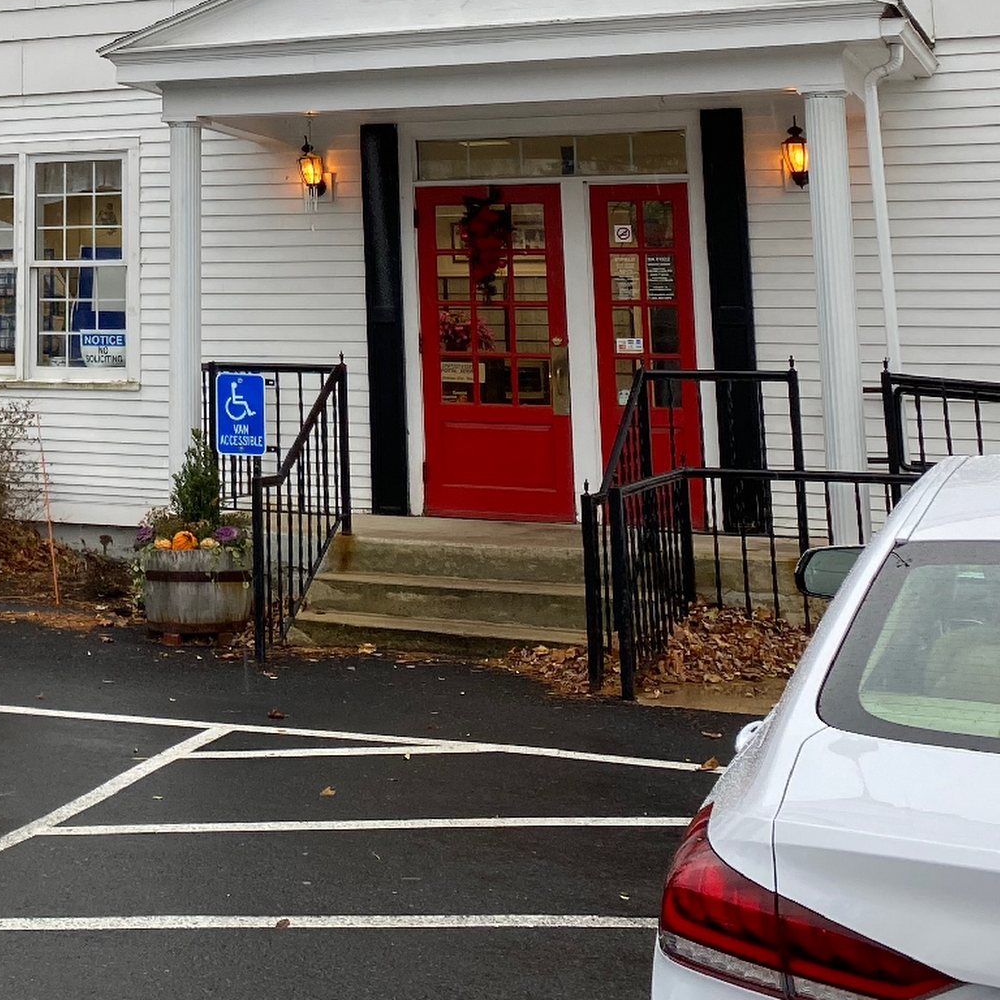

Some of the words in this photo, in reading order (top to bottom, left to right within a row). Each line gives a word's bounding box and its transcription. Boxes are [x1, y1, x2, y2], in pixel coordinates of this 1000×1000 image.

[84, 335, 123, 345] NOTICE
[98, 346, 109, 355] NO
[233, 424, 249, 435] VAN
[220, 434, 263, 447] ACCESSIBLE
